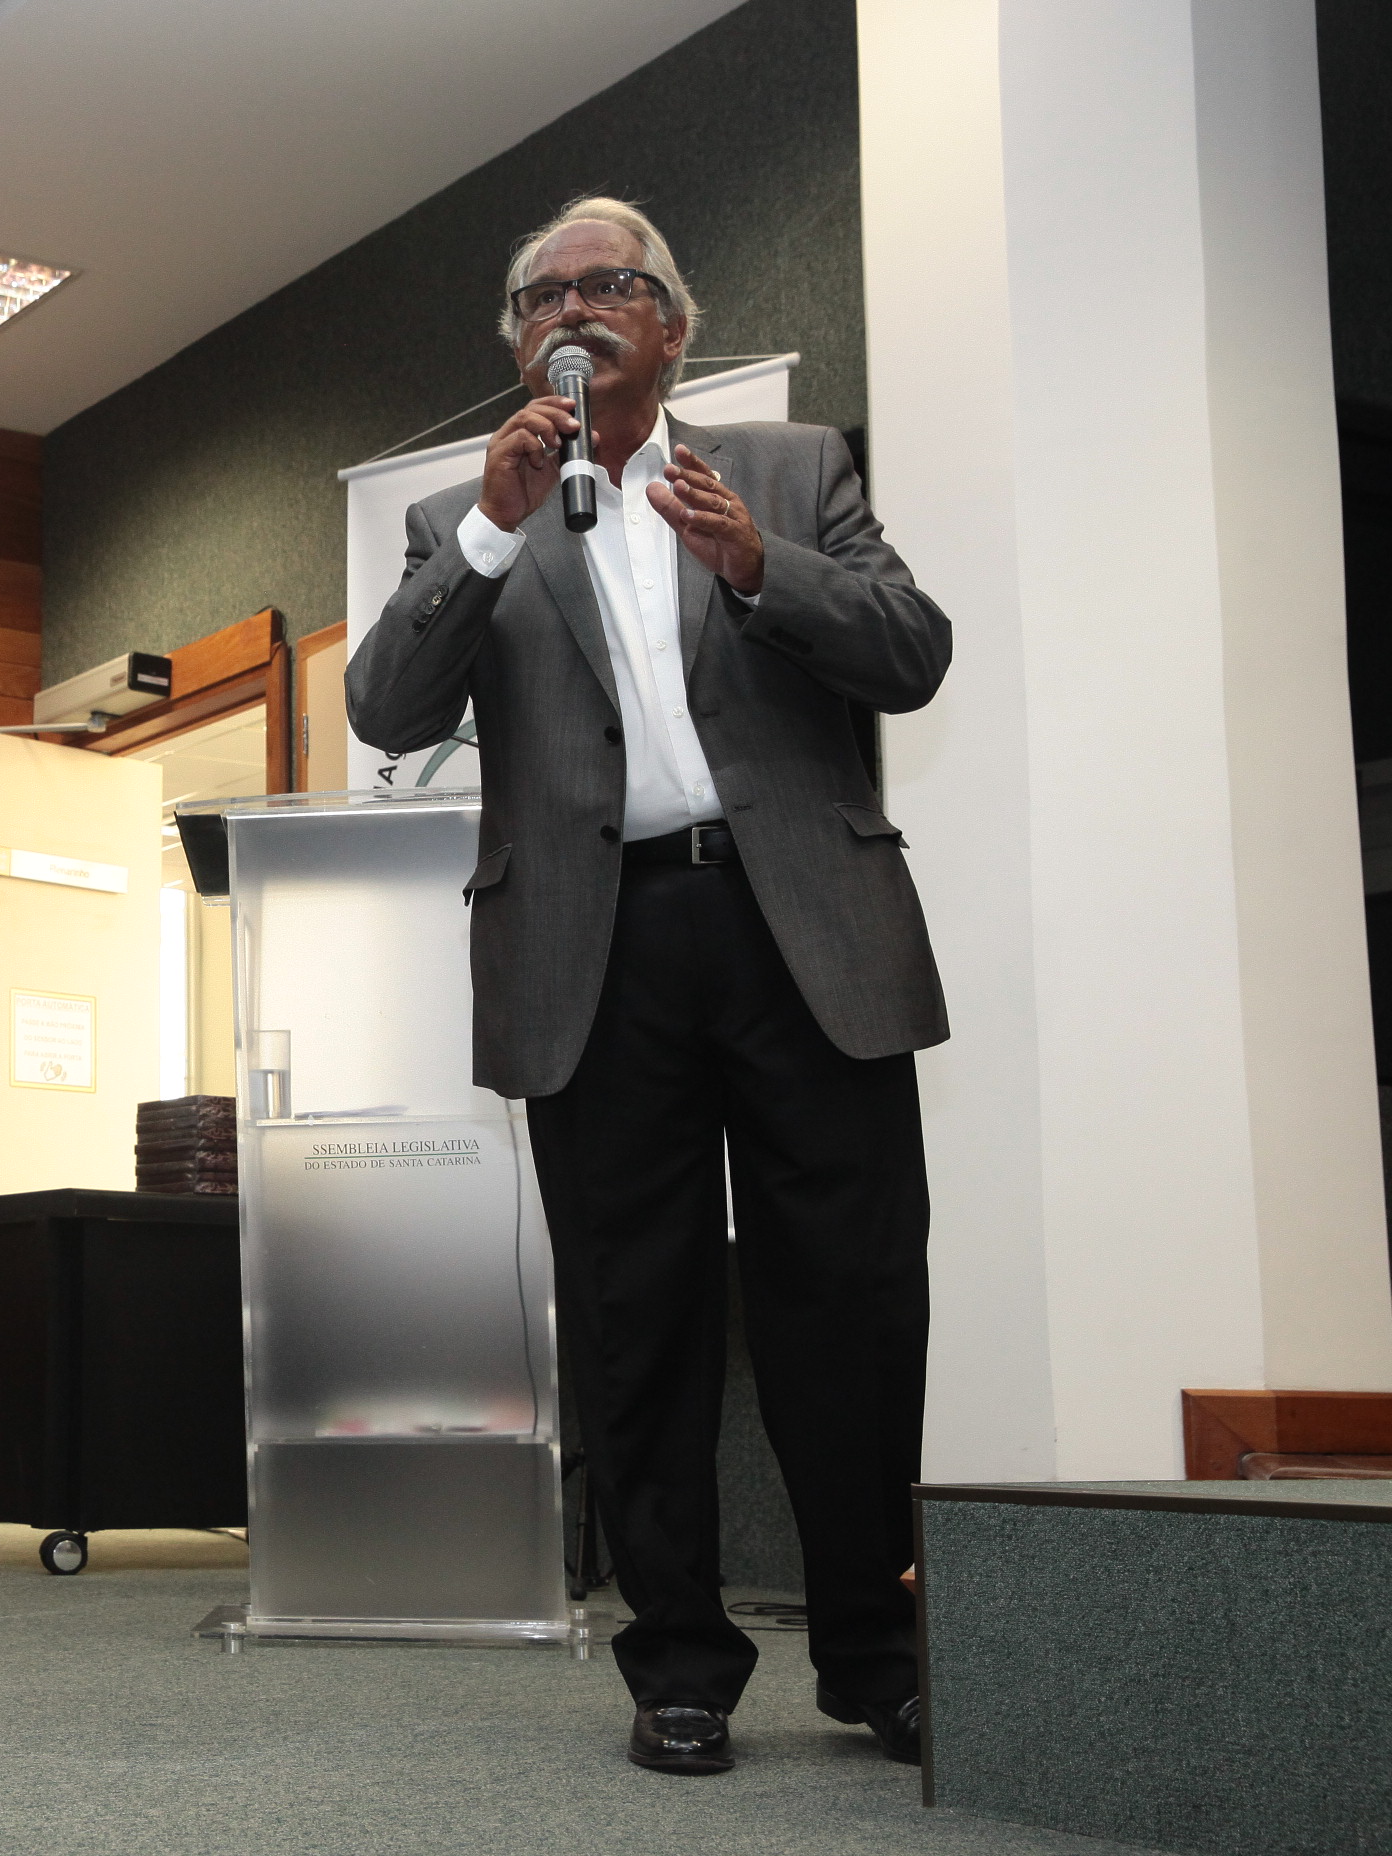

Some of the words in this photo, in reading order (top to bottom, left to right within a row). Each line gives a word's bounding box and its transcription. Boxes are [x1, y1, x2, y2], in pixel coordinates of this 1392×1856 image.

[312, 1142, 389, 1156] SSEMBLEIA
[392, 1139, 480, 1153] LEGISLATIVA
[304, 1161, 320, 1170] DO
[323, 1160, 367, 1170] ESTADO
[370, 1159, 386, 1169] DE
[389, 1158, 424, 1168] SANTA
[426, 1156, 482, 1167] CATARINA
